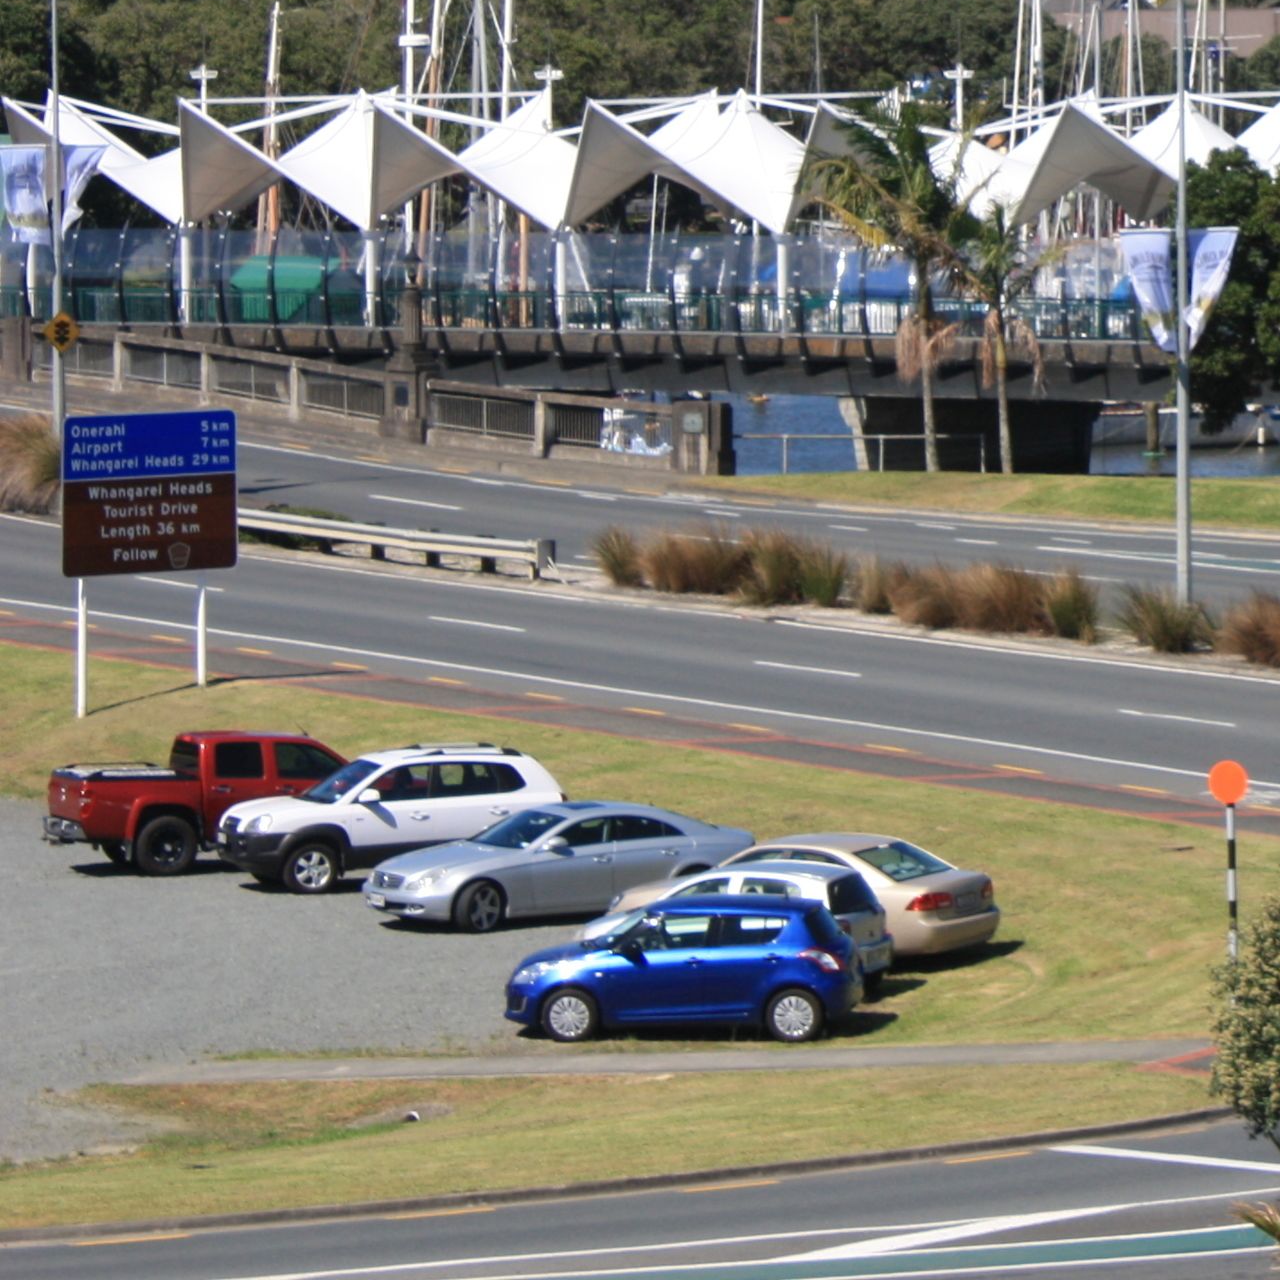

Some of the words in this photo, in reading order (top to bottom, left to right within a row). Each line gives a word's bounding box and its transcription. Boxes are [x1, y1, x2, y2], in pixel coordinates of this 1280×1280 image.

[71, 423, 125, 438] Onerahi
[201, 420, 209, 432] 5
[212, 421, 229, 431] km
[71, 441, 123, 457] Airport
[201, 436, 209, 448] 7
[212, 437, 229, 447] km
[71, 456, 138, 474] Whangarei
[145, 454, 184, 468] Heads
[192, 453, 209, 466] 29
[212, 454, 230, 464] km
[88, 483, 162, 500] Whangarei
[170, 481, 213, 495] Heads
[104, 504, 154, 519] Tourist
[161, 502, 198, 516] Drive
[101, 524, 150, 540] Length
[157, 522, 175, 536] 36
[181, 523, 200, 534] km
[113, 548, 158, 562] Follow
